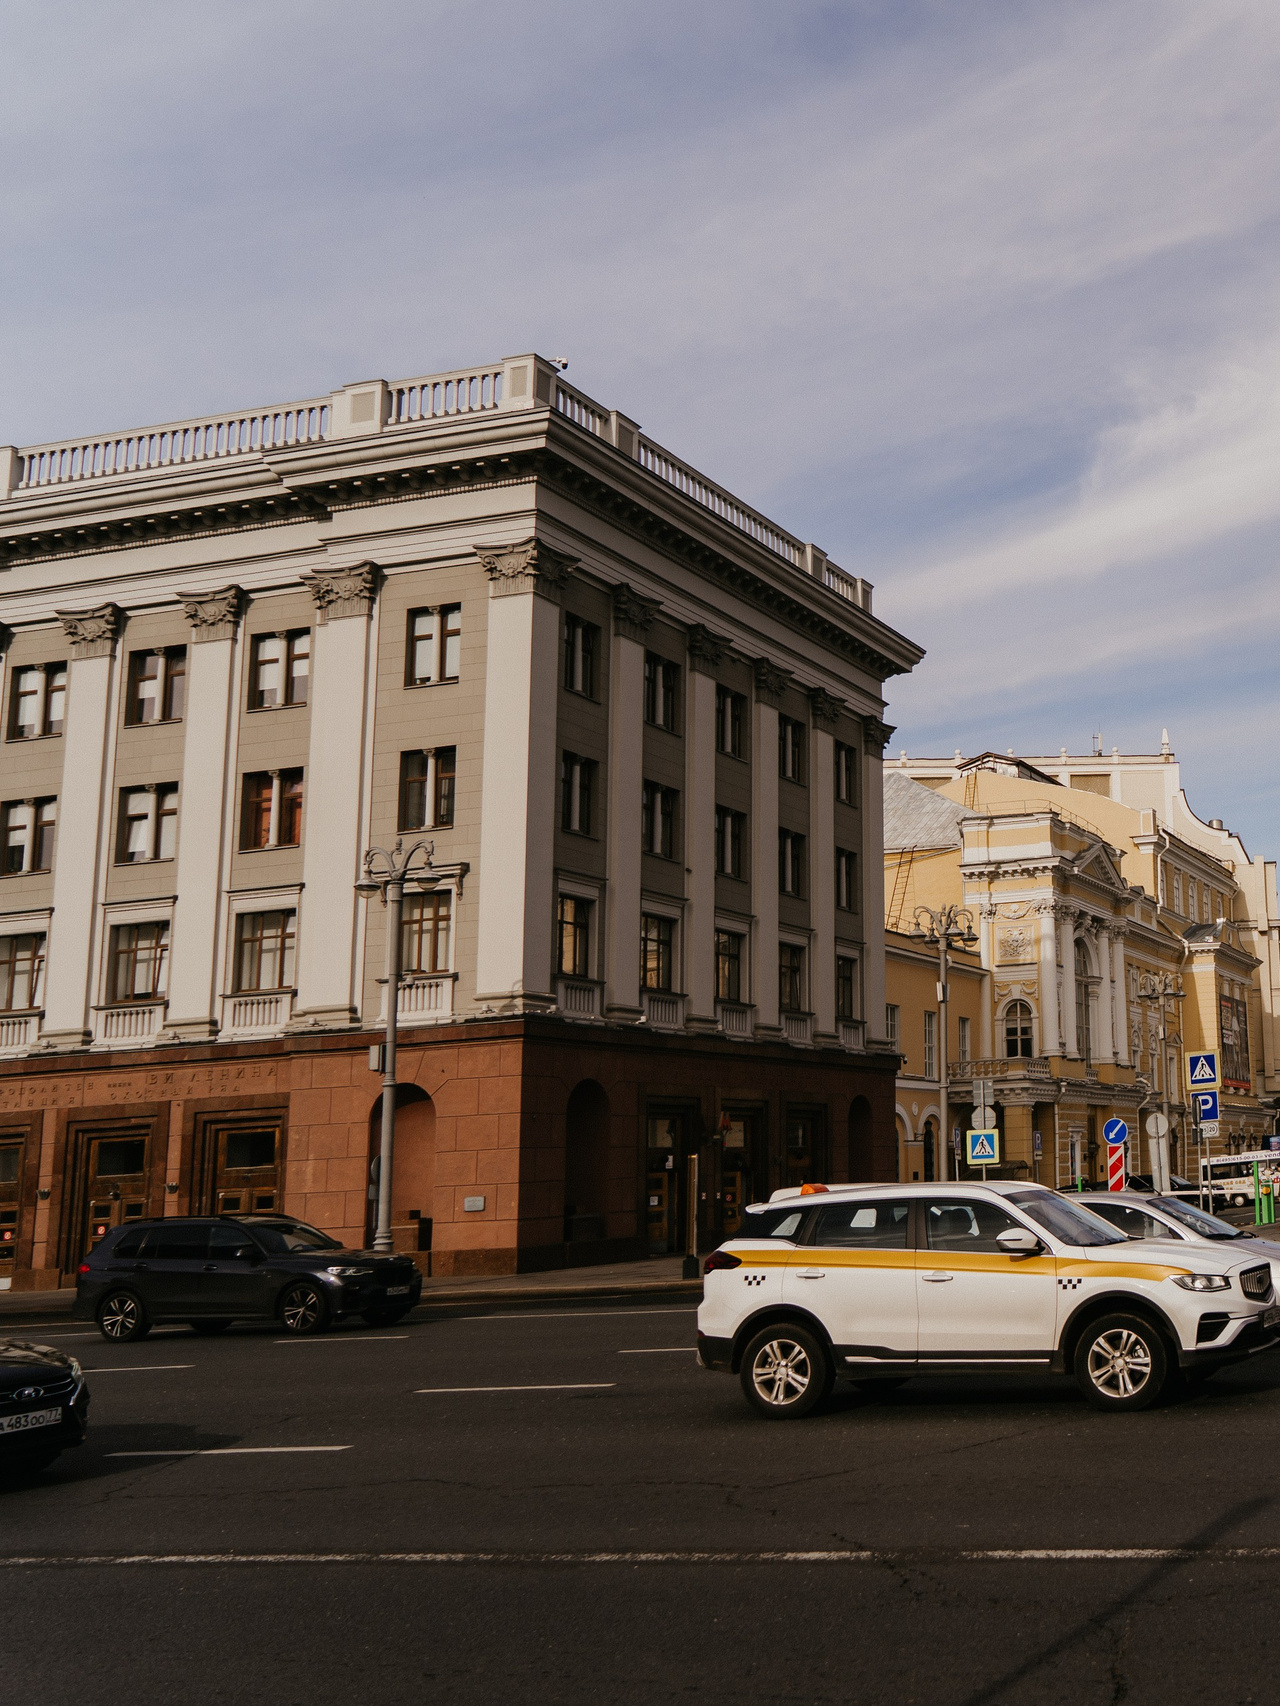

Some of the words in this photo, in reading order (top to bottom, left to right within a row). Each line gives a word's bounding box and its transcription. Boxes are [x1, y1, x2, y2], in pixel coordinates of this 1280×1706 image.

[190, 1065, 277, 1083] ЛЕНИНА
[1198, 1095, 1213, 1117] P
[1035, 1133, 1041, 1148] P
[48, 1409, 59, 1418] 77
